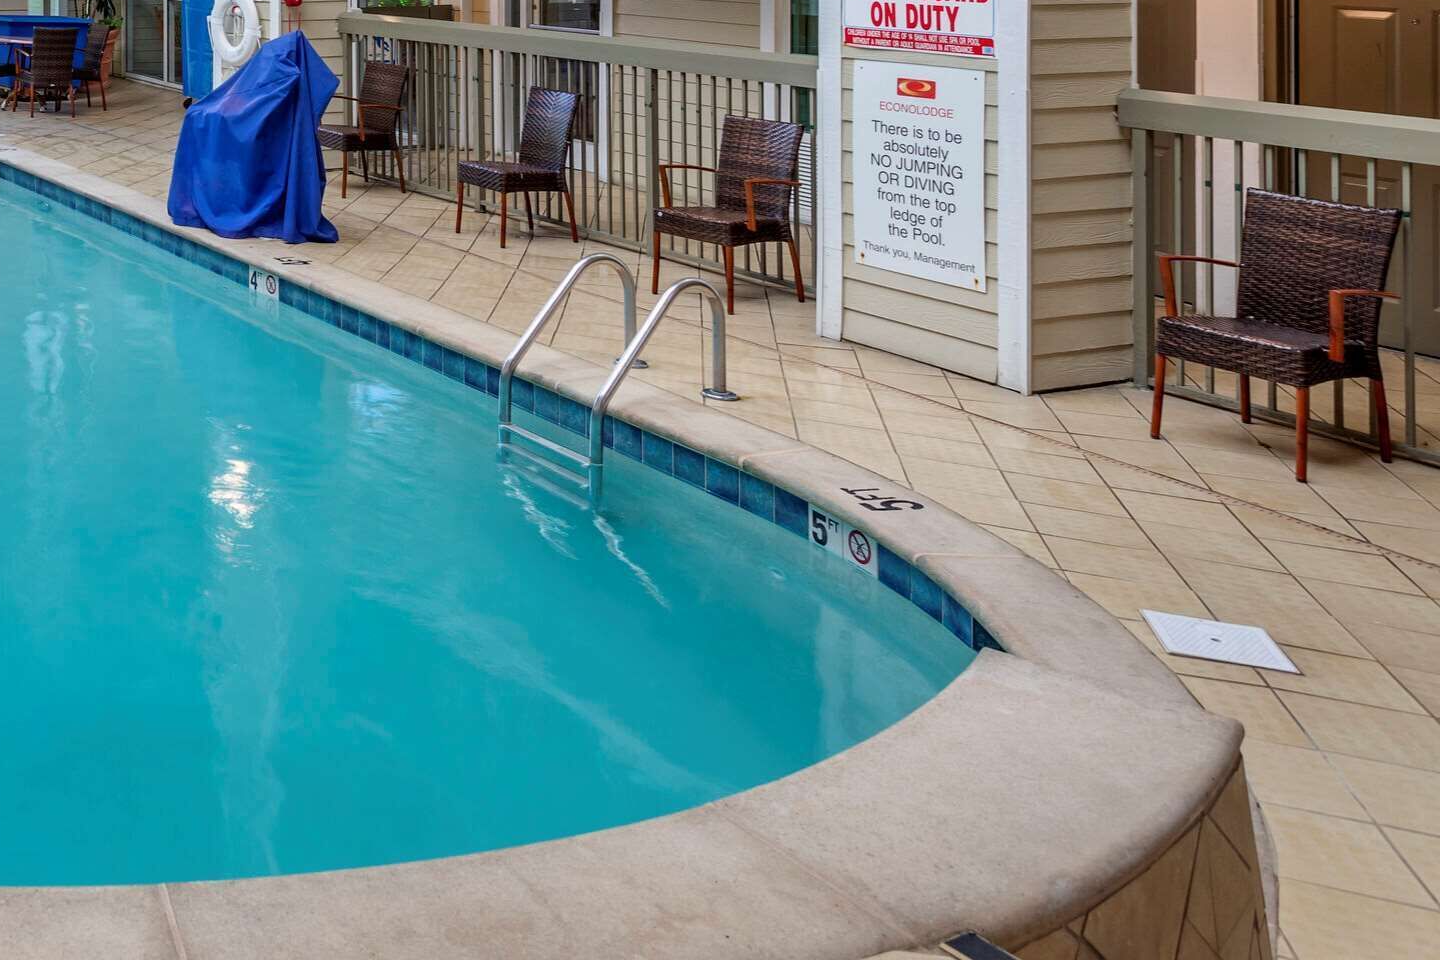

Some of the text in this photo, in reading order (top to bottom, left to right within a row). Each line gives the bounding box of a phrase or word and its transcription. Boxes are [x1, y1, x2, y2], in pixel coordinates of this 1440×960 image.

[871, 1, 960, 32] ON DUTY
[847, 28, 866, 37] CHILDREN
[867, 30, 881, 38] UNDER
[882, 31, 890, 39] THE
[891, 32, 900, 40] AGE
[914, 33, 928, 42] SHALL
[880, 101, 954, 119] ECONOLODGE
[872, 120, 962, 144] There is to be
[883, 140, 949, 163] absolutely
[871, 153, 963, 179] NO JUMPING
[878, 171, 955, 195] OR DIVING
[877, 187, 956, 215] from the top
[890, 207, 943, 228] ledge of
[888, 223, 945, 246] the Pool.
[863, 240, 976, 273] Thank you, Management
[251, 271, 257, 290] 4
[840, 487, 924, 511] 5 FT
[812, 510, 839, 546] 5 FT
